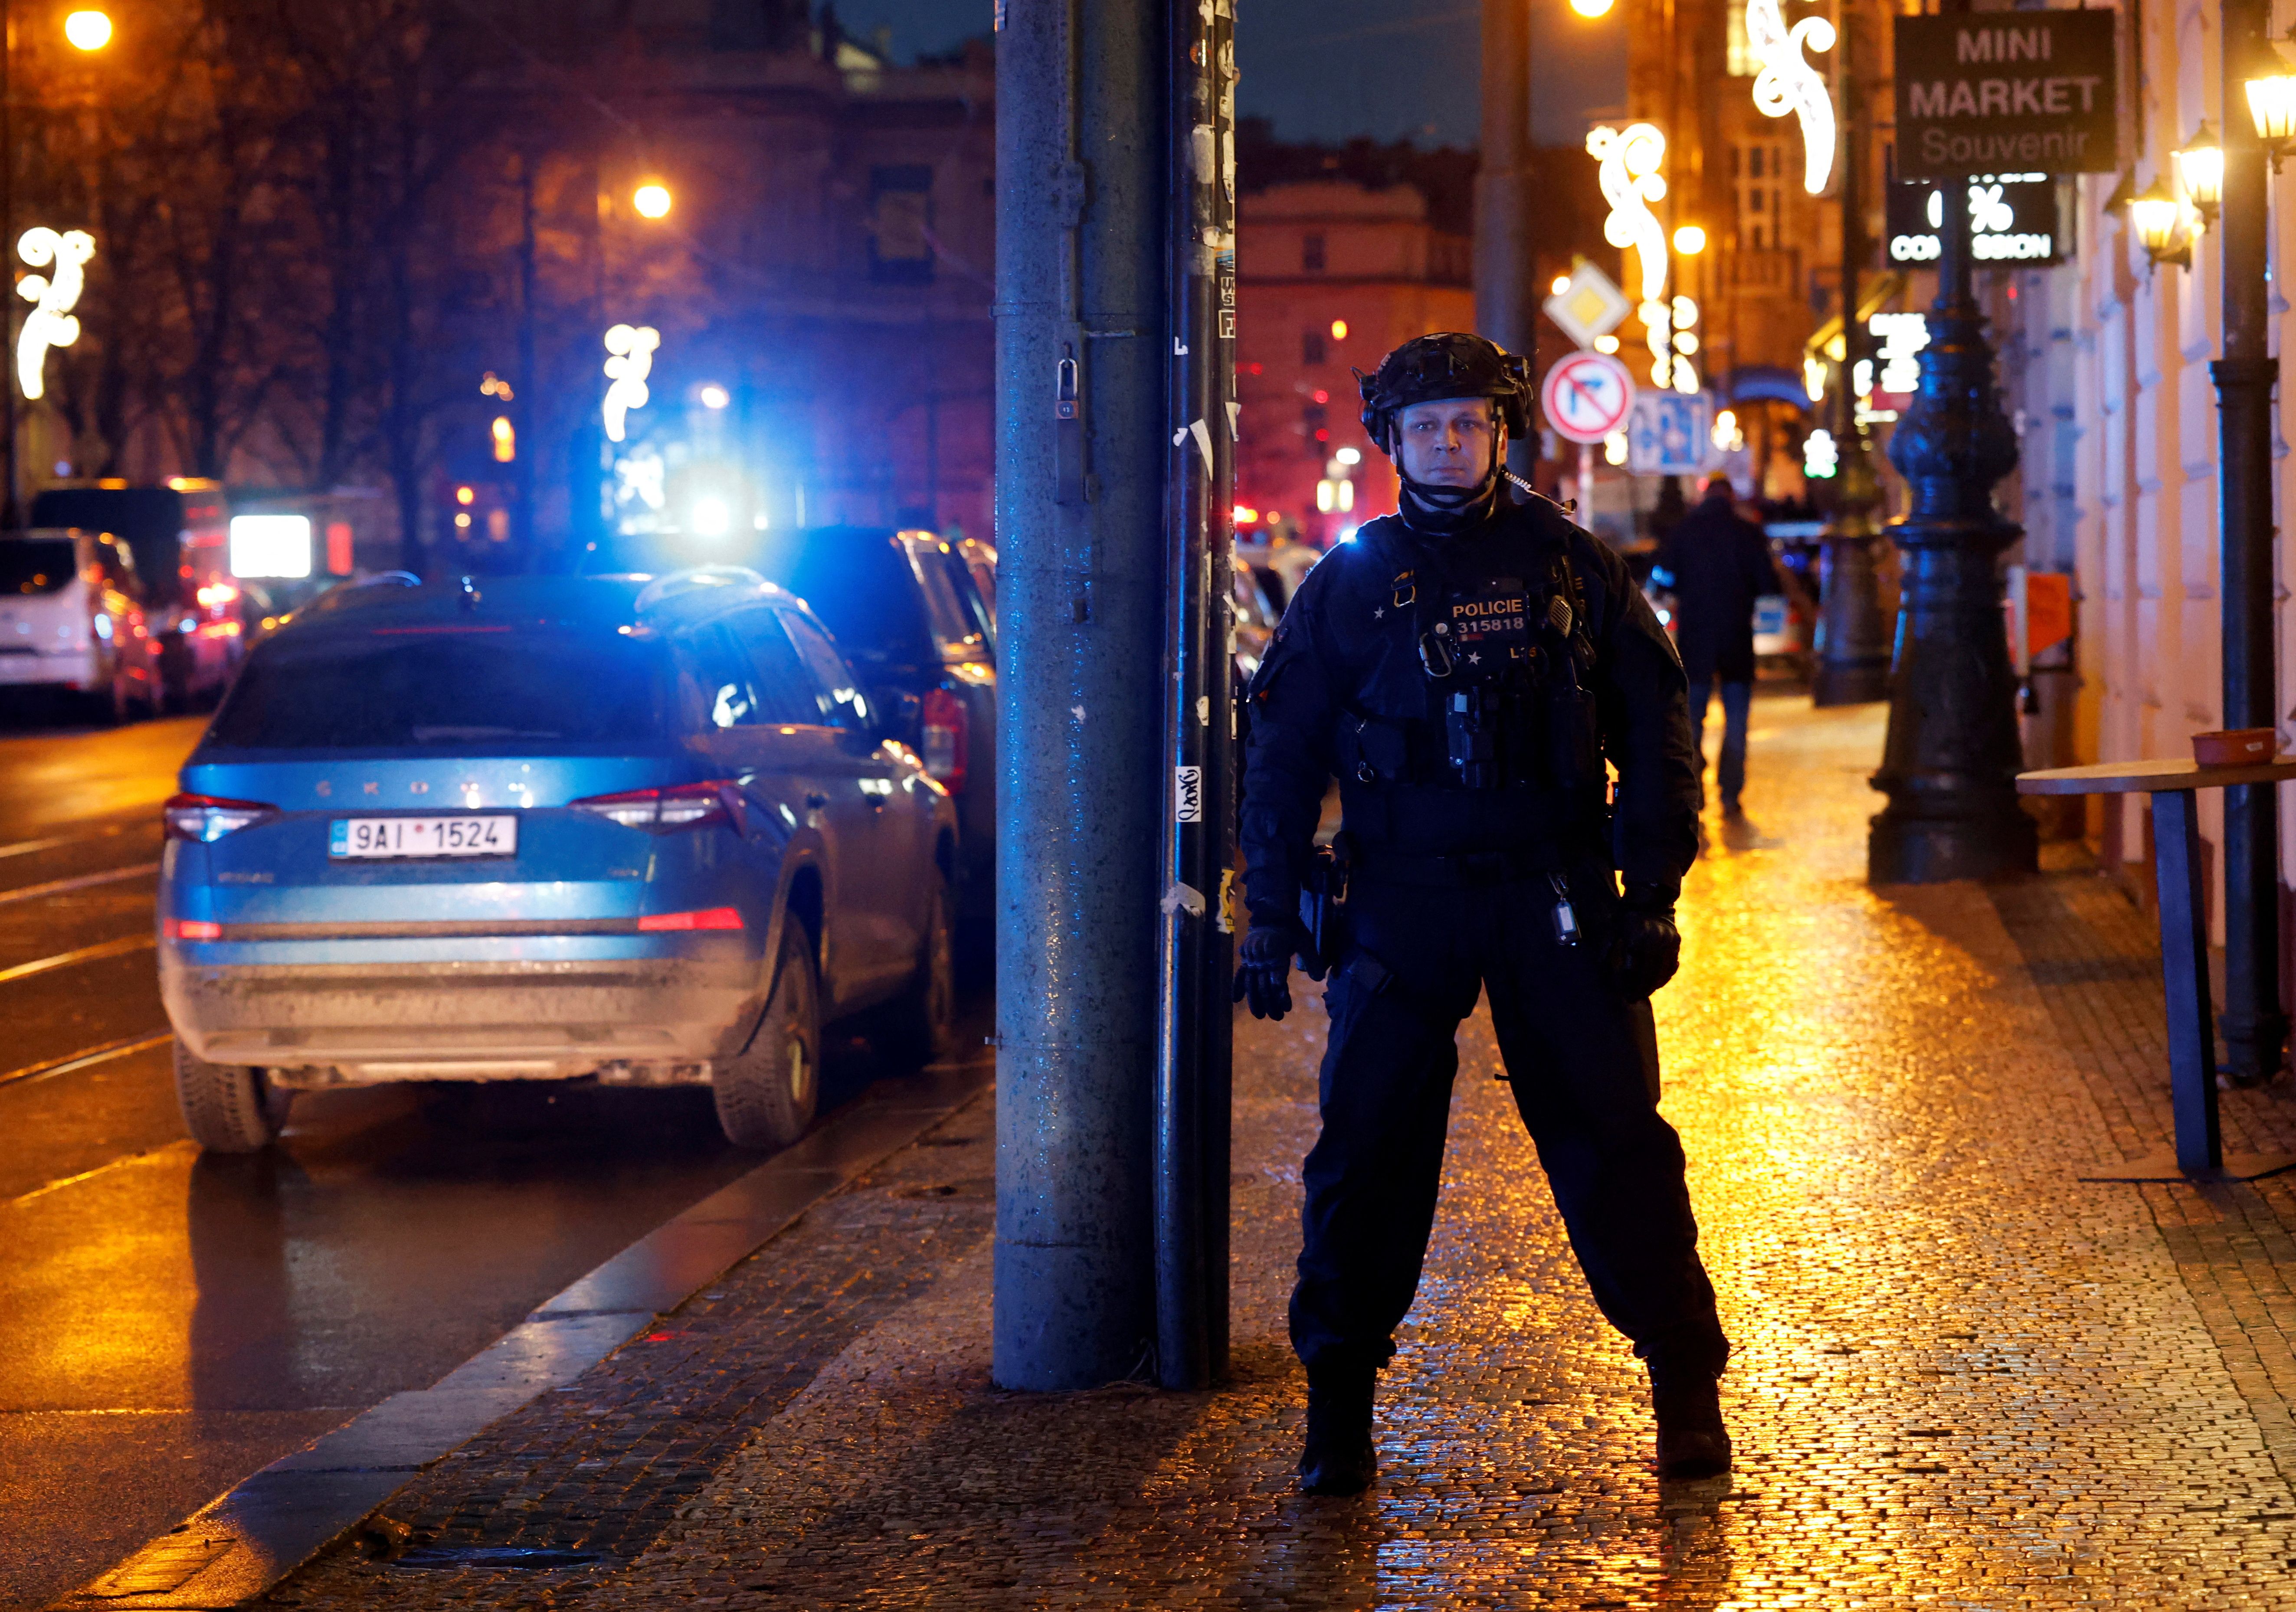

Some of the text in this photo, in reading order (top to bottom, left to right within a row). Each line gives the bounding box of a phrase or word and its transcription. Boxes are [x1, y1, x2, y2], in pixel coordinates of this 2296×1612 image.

[1957, 27, 2052, 64] MINI
[1910, 76, 2101, 117] MARKET
[1922, 126, 2090, 163] Souvenir
[1452, 598, 1523, 618] POLICIE
[1458, 617, 1524, 634] 315818
[433, 821, 498, 848] 1524
